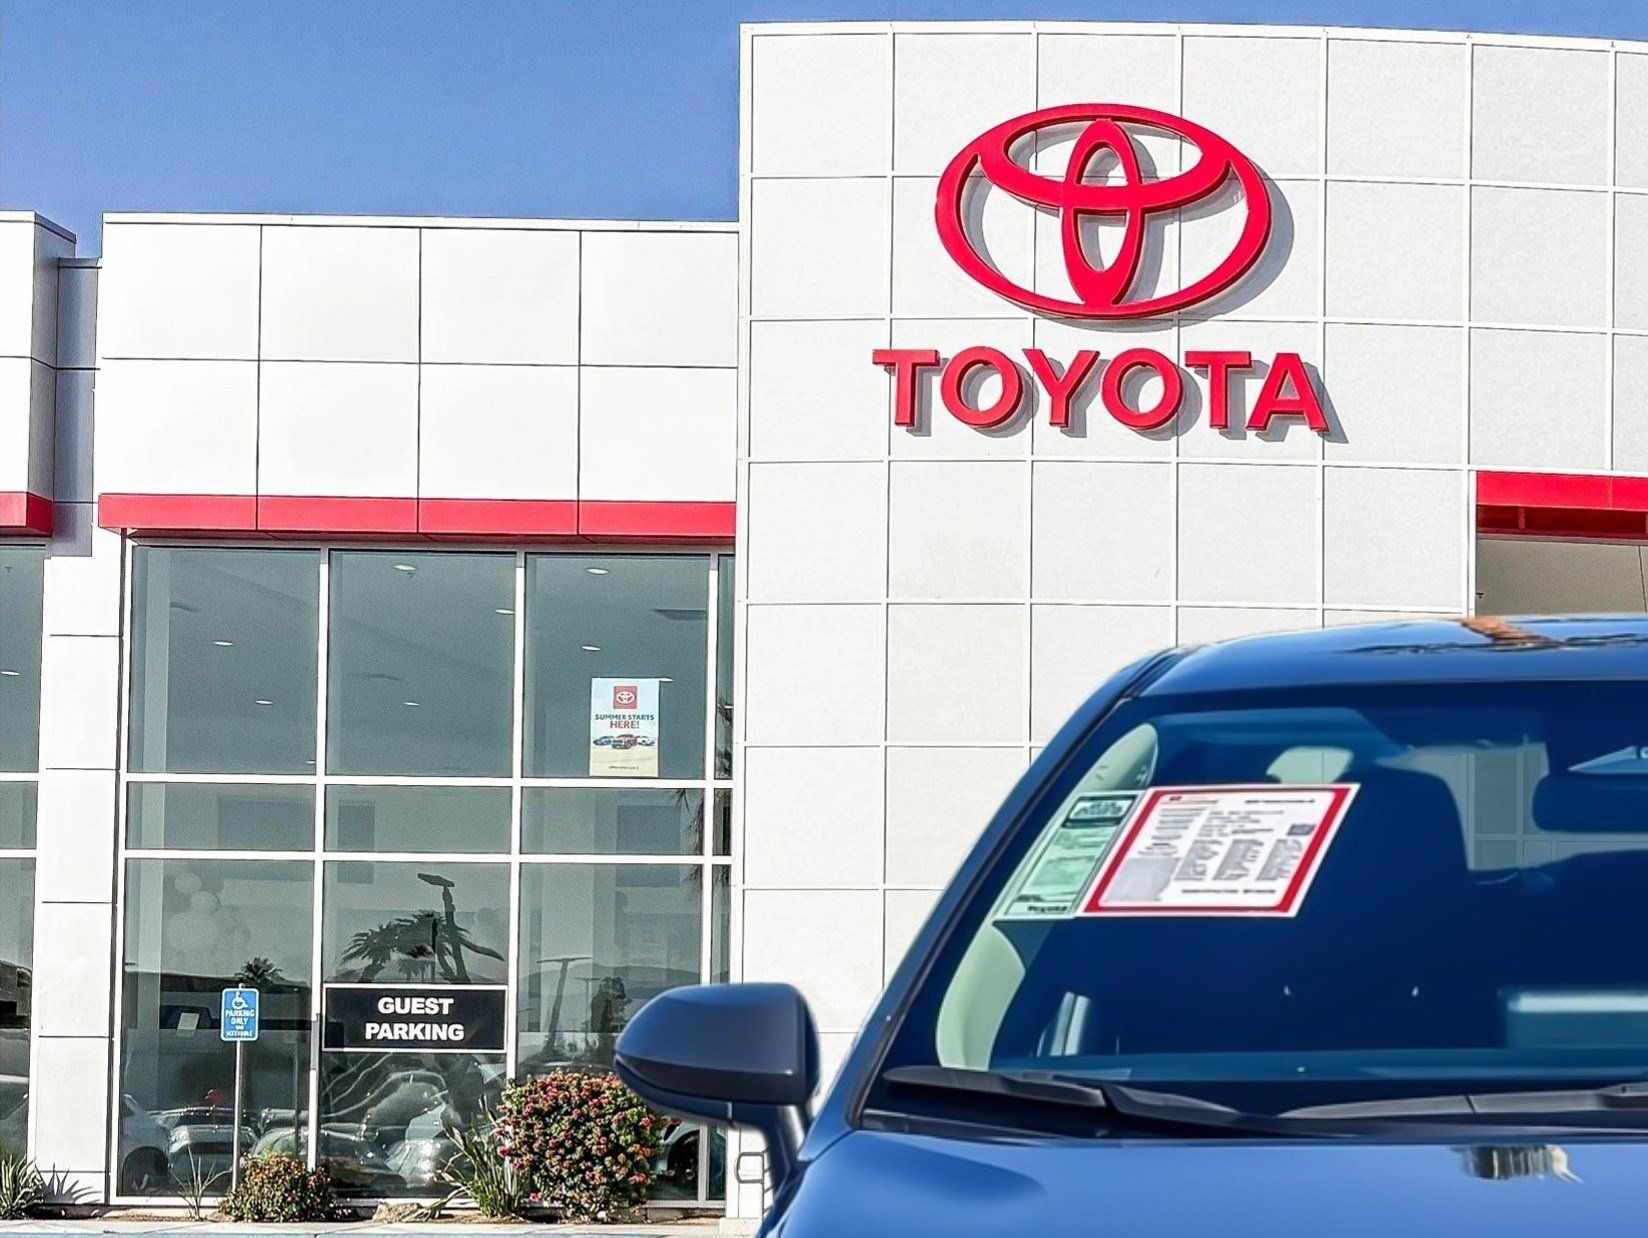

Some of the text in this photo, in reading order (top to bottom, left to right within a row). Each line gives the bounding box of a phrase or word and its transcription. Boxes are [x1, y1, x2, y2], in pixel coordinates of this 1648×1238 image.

[873, 346, 1330, 432] TOYOTA
[610, 721, 640, 729] HERE!
[378, 997, 454, 1015] GUEST
[225, 1009, 255, 1018] PARKING
[231, 1017, 249, 1025] ONLY
[365, 1022, 465, 1041] PARKING
